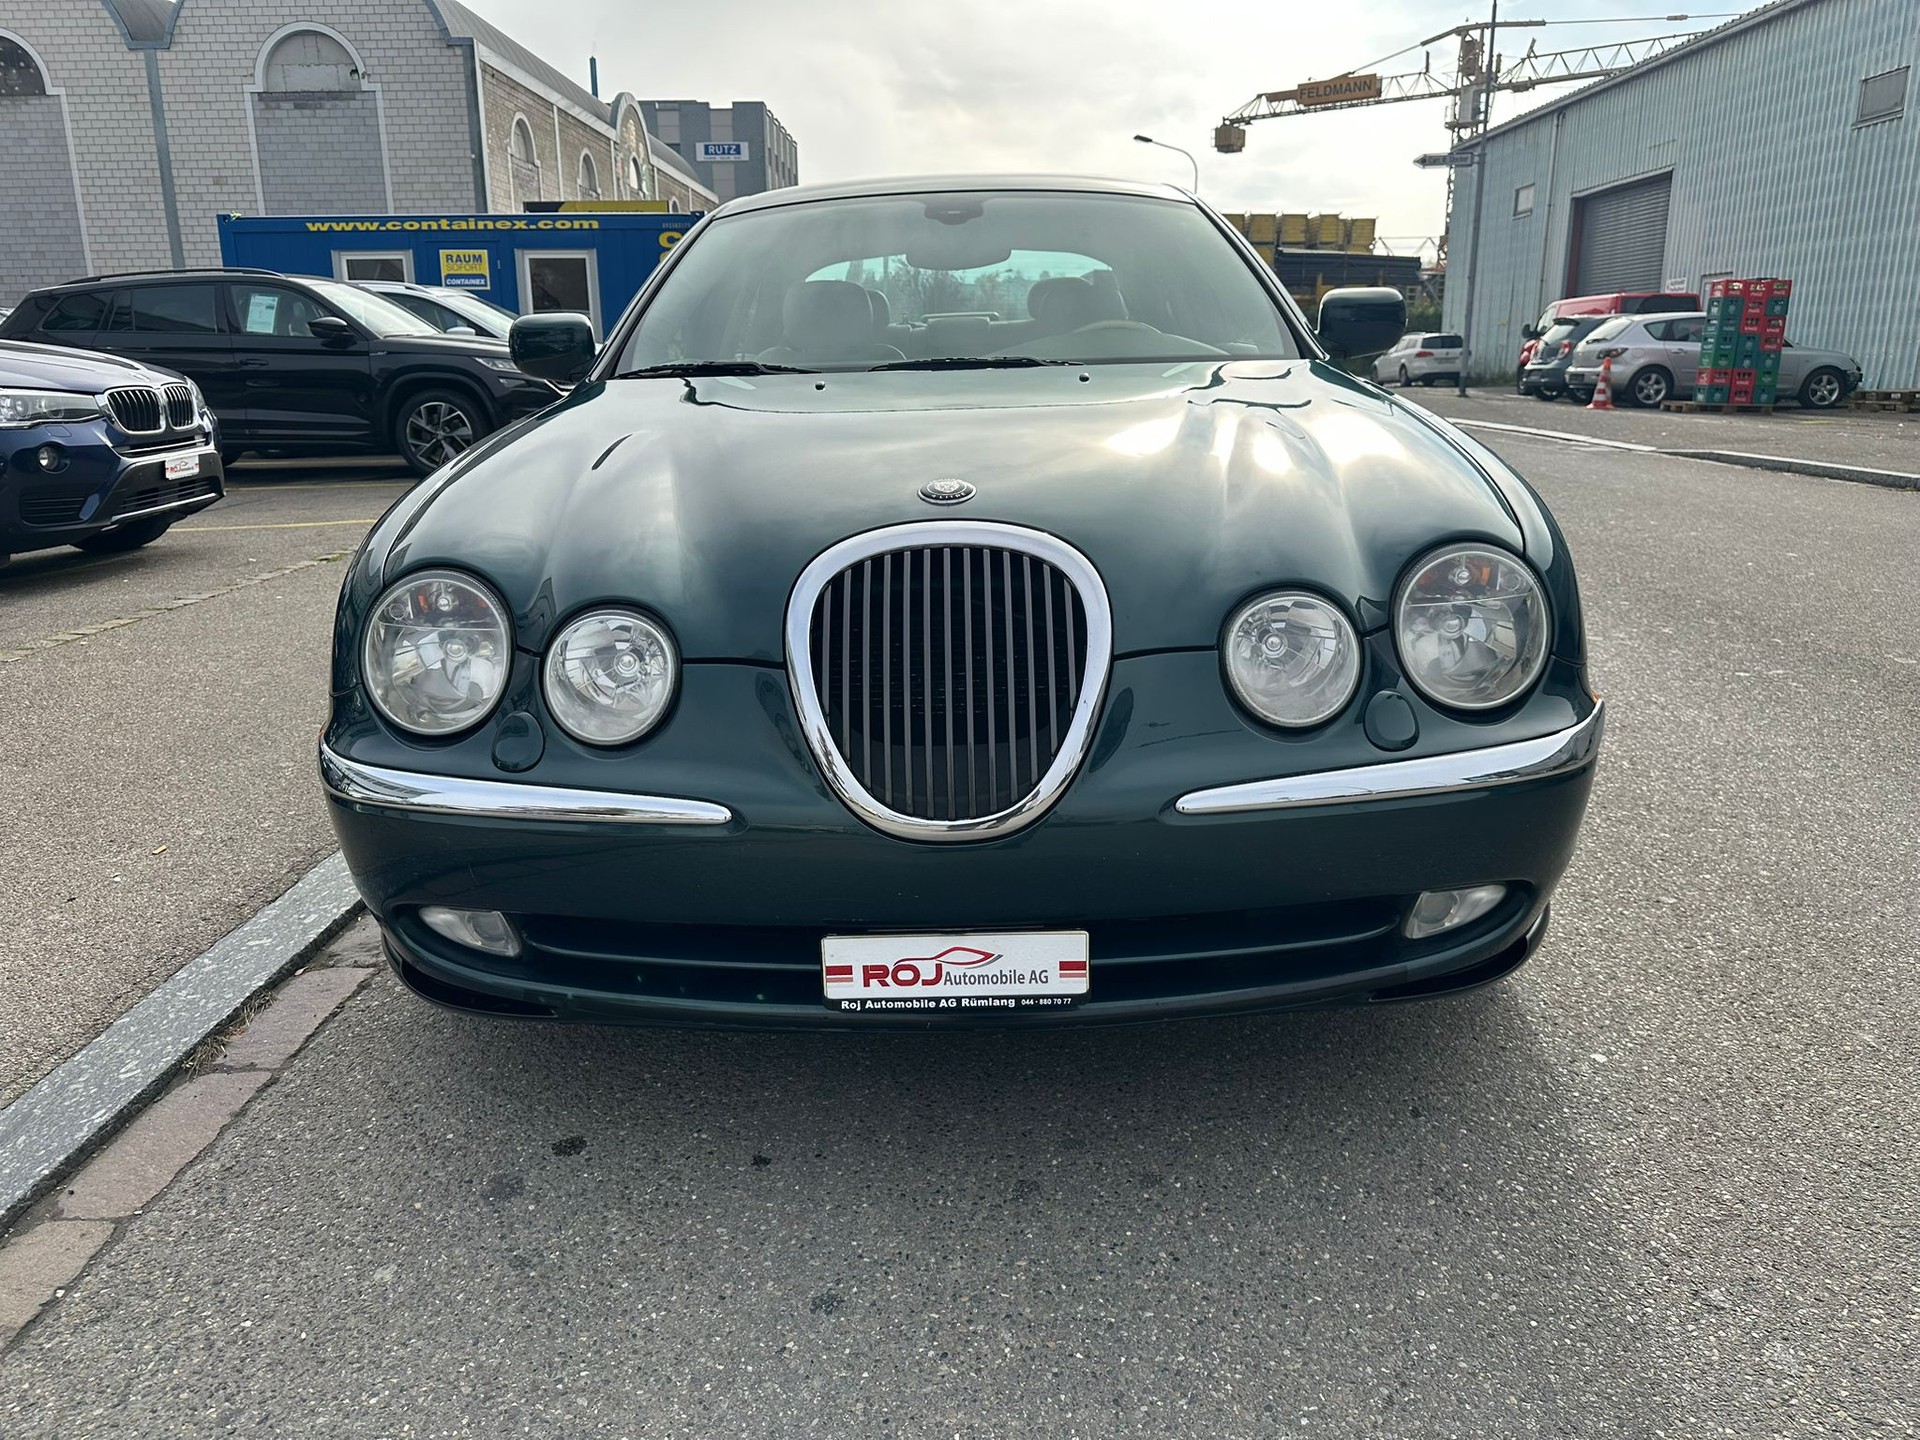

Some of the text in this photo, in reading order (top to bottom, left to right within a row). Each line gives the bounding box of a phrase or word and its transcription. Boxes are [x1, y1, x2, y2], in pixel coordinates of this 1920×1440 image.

[1300, 79, 1372, 99] FELDMANN
[708, 145, 737, 155] RUTZ
[305, 218, 599, 231] www.containex.com
[445, 254, 483, 263] RAUM
[446, 263, 482, 271] SOFORT
[862, 963, 1049, 988] ROJ Automobile AG
[841, 1000, 861, 1011] Roj
[865, 999, 936, 1009] Automobile
[939, 998, 957, 1008] AG
[961, 997, 1016, 1008] Rümlang
